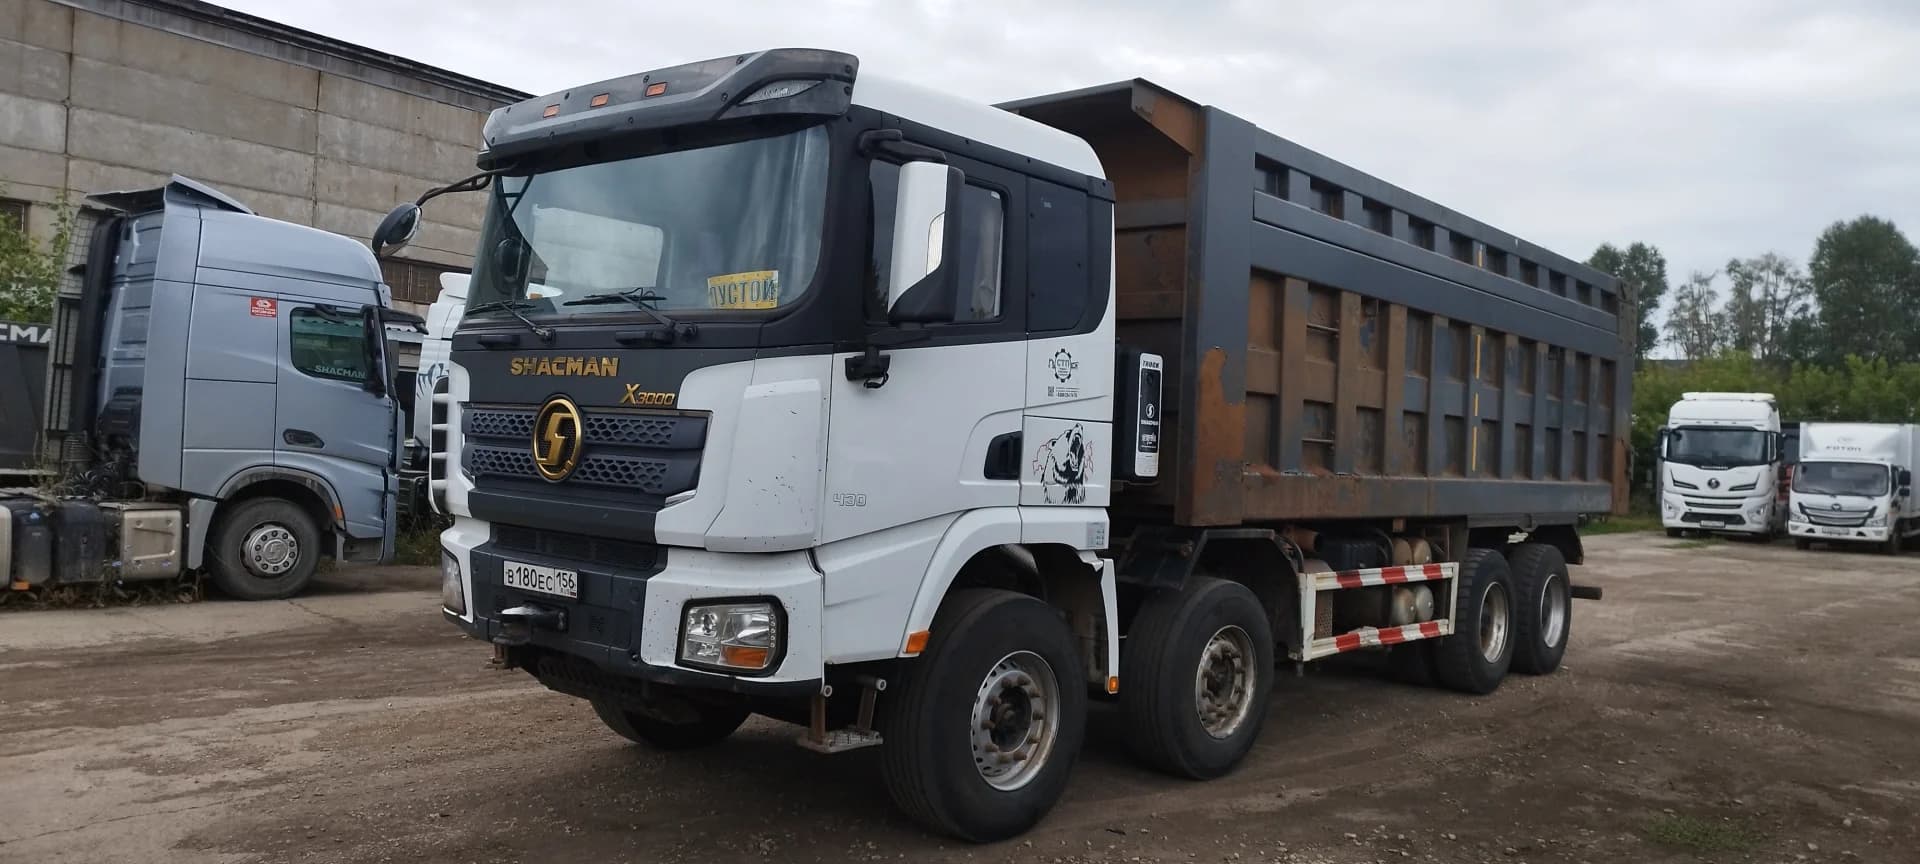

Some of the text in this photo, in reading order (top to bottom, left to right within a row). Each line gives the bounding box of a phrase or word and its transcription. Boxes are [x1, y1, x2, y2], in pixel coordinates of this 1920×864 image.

[314, 364, 366, 379] SHACMAN
[511, 356, 620, 377] SHACMAN
[620, 384, 675, 405] X3000
[833, 493, 867, 506] 430
[556, 571, 575, 589] 156
